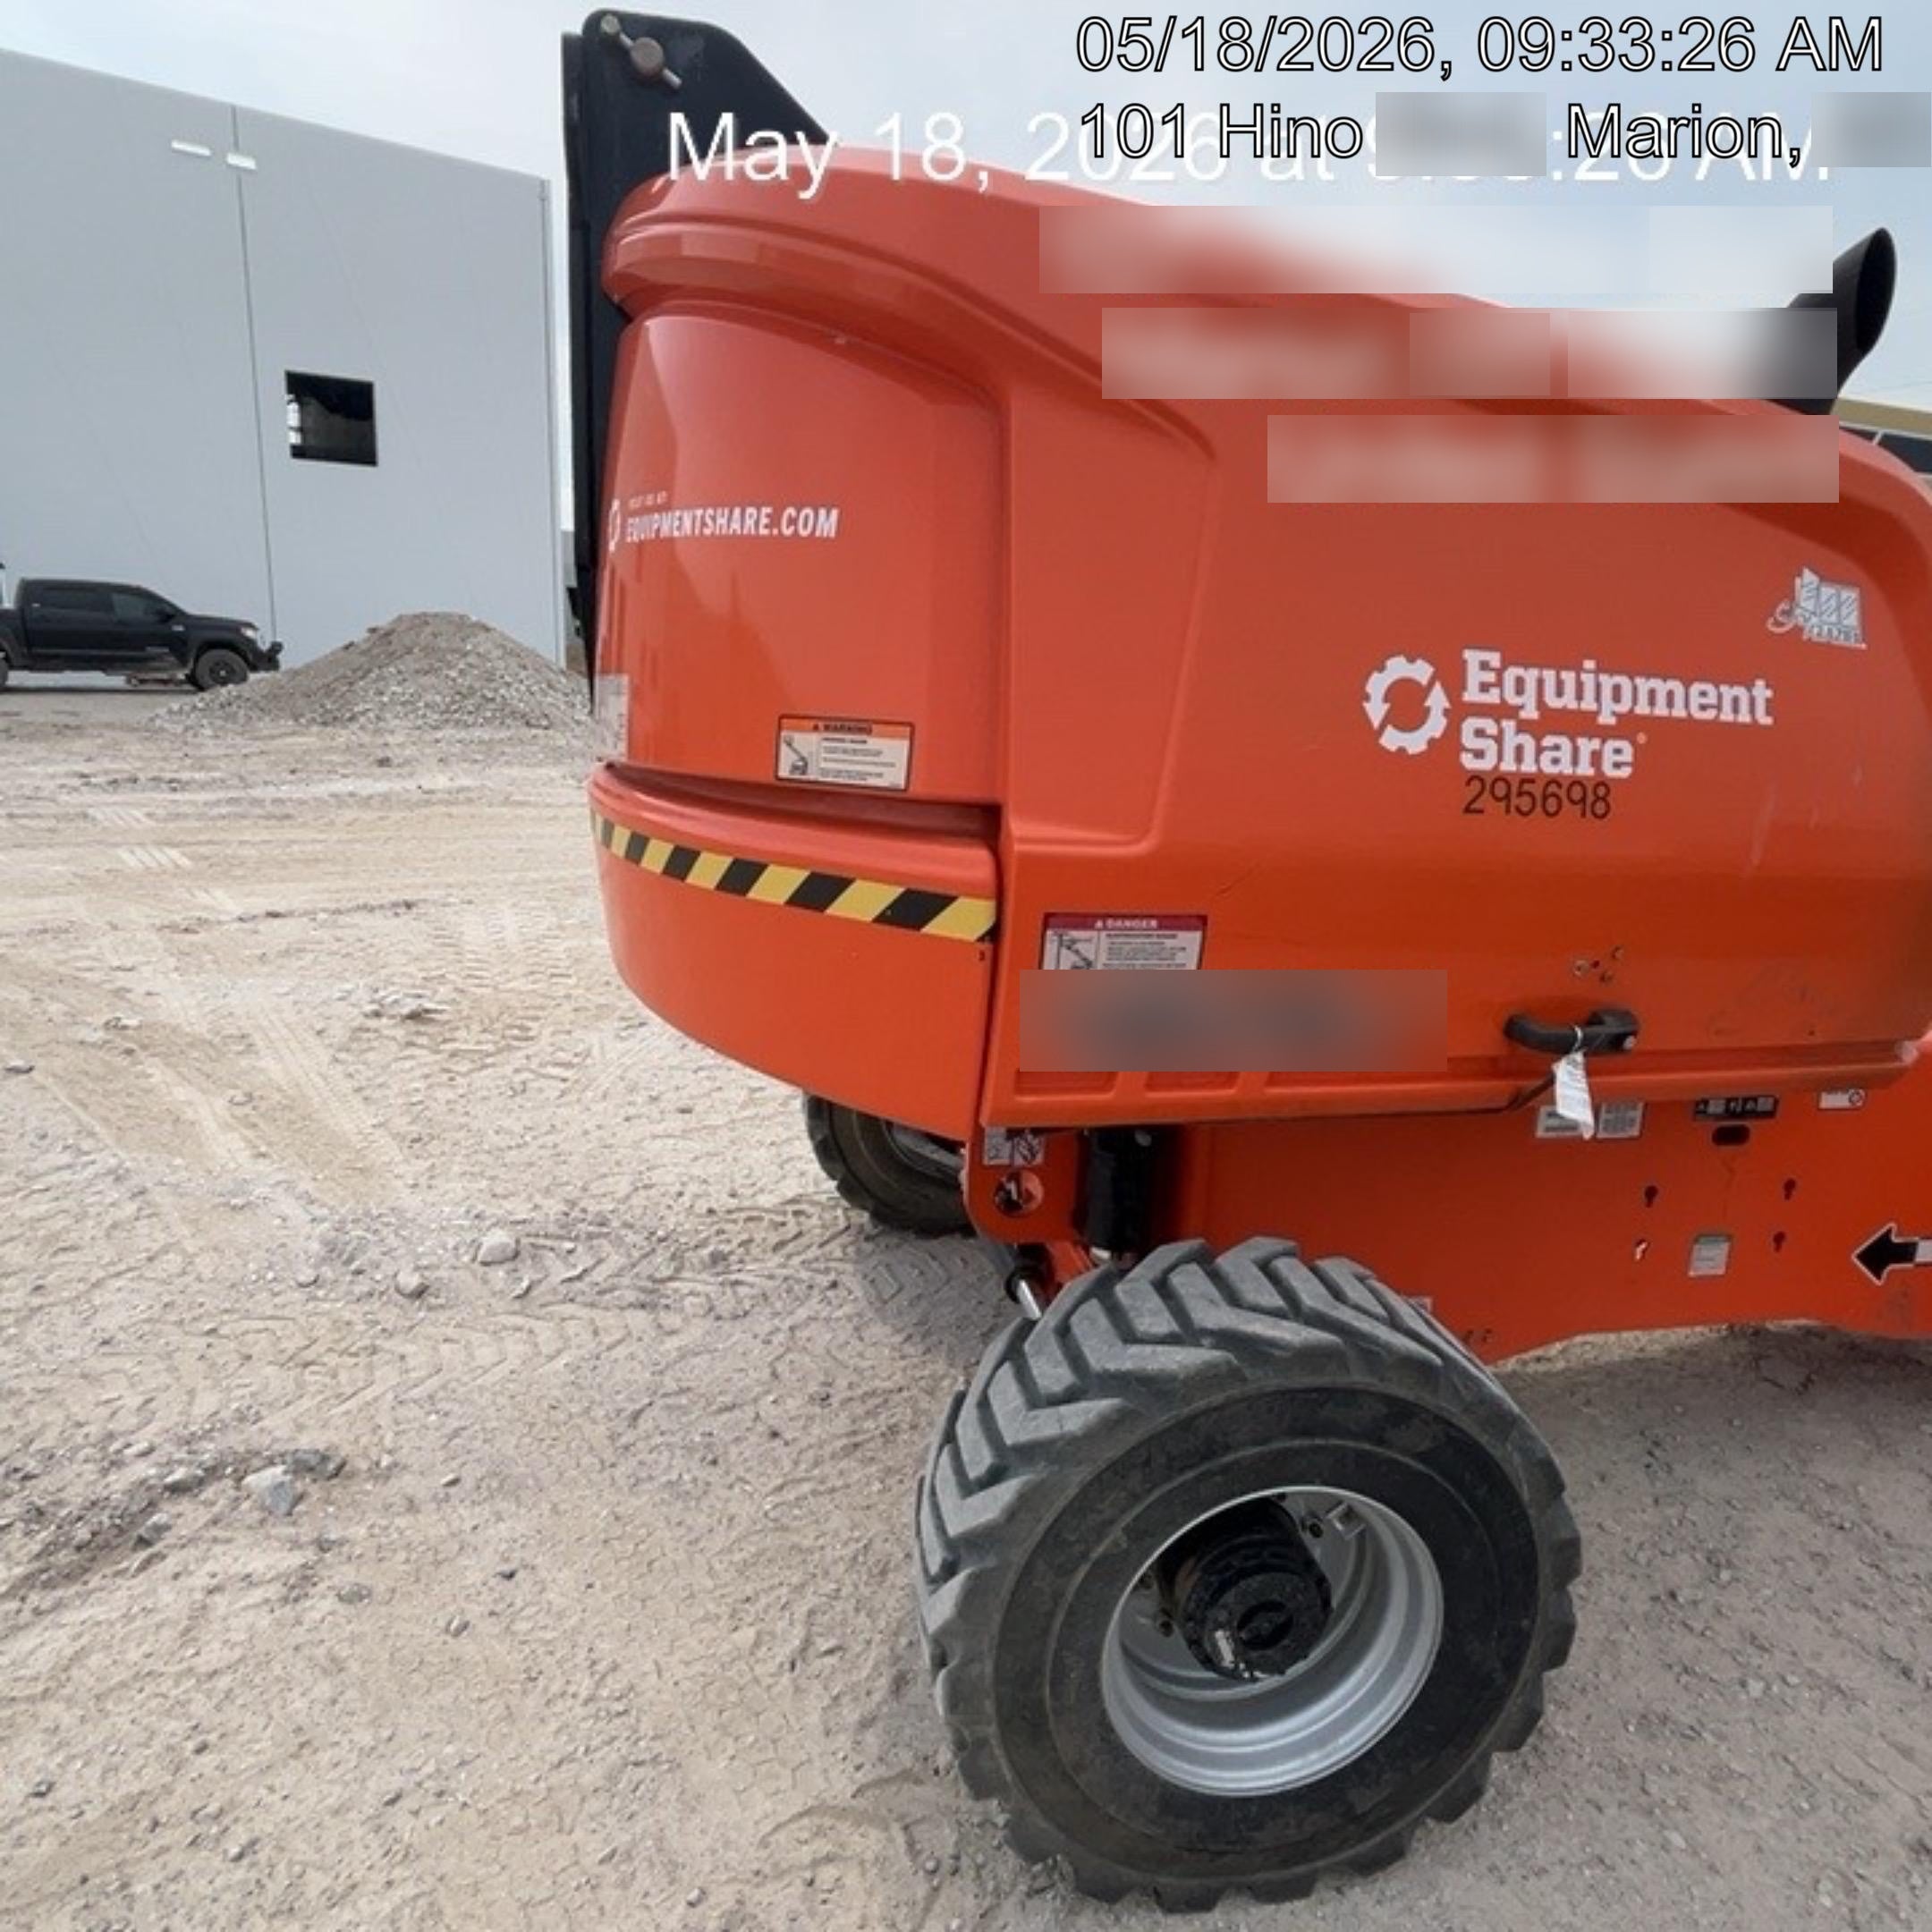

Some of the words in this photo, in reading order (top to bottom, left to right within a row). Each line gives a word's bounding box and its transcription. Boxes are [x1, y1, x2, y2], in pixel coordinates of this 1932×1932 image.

[626, 506, 839, 543] EQUIPMENTSHARE.COM
[1462, 648, 1774, 725] Equipment
[1460, 716, 1634, 778] Share
[1462, 775, 1611, 819] 295698
